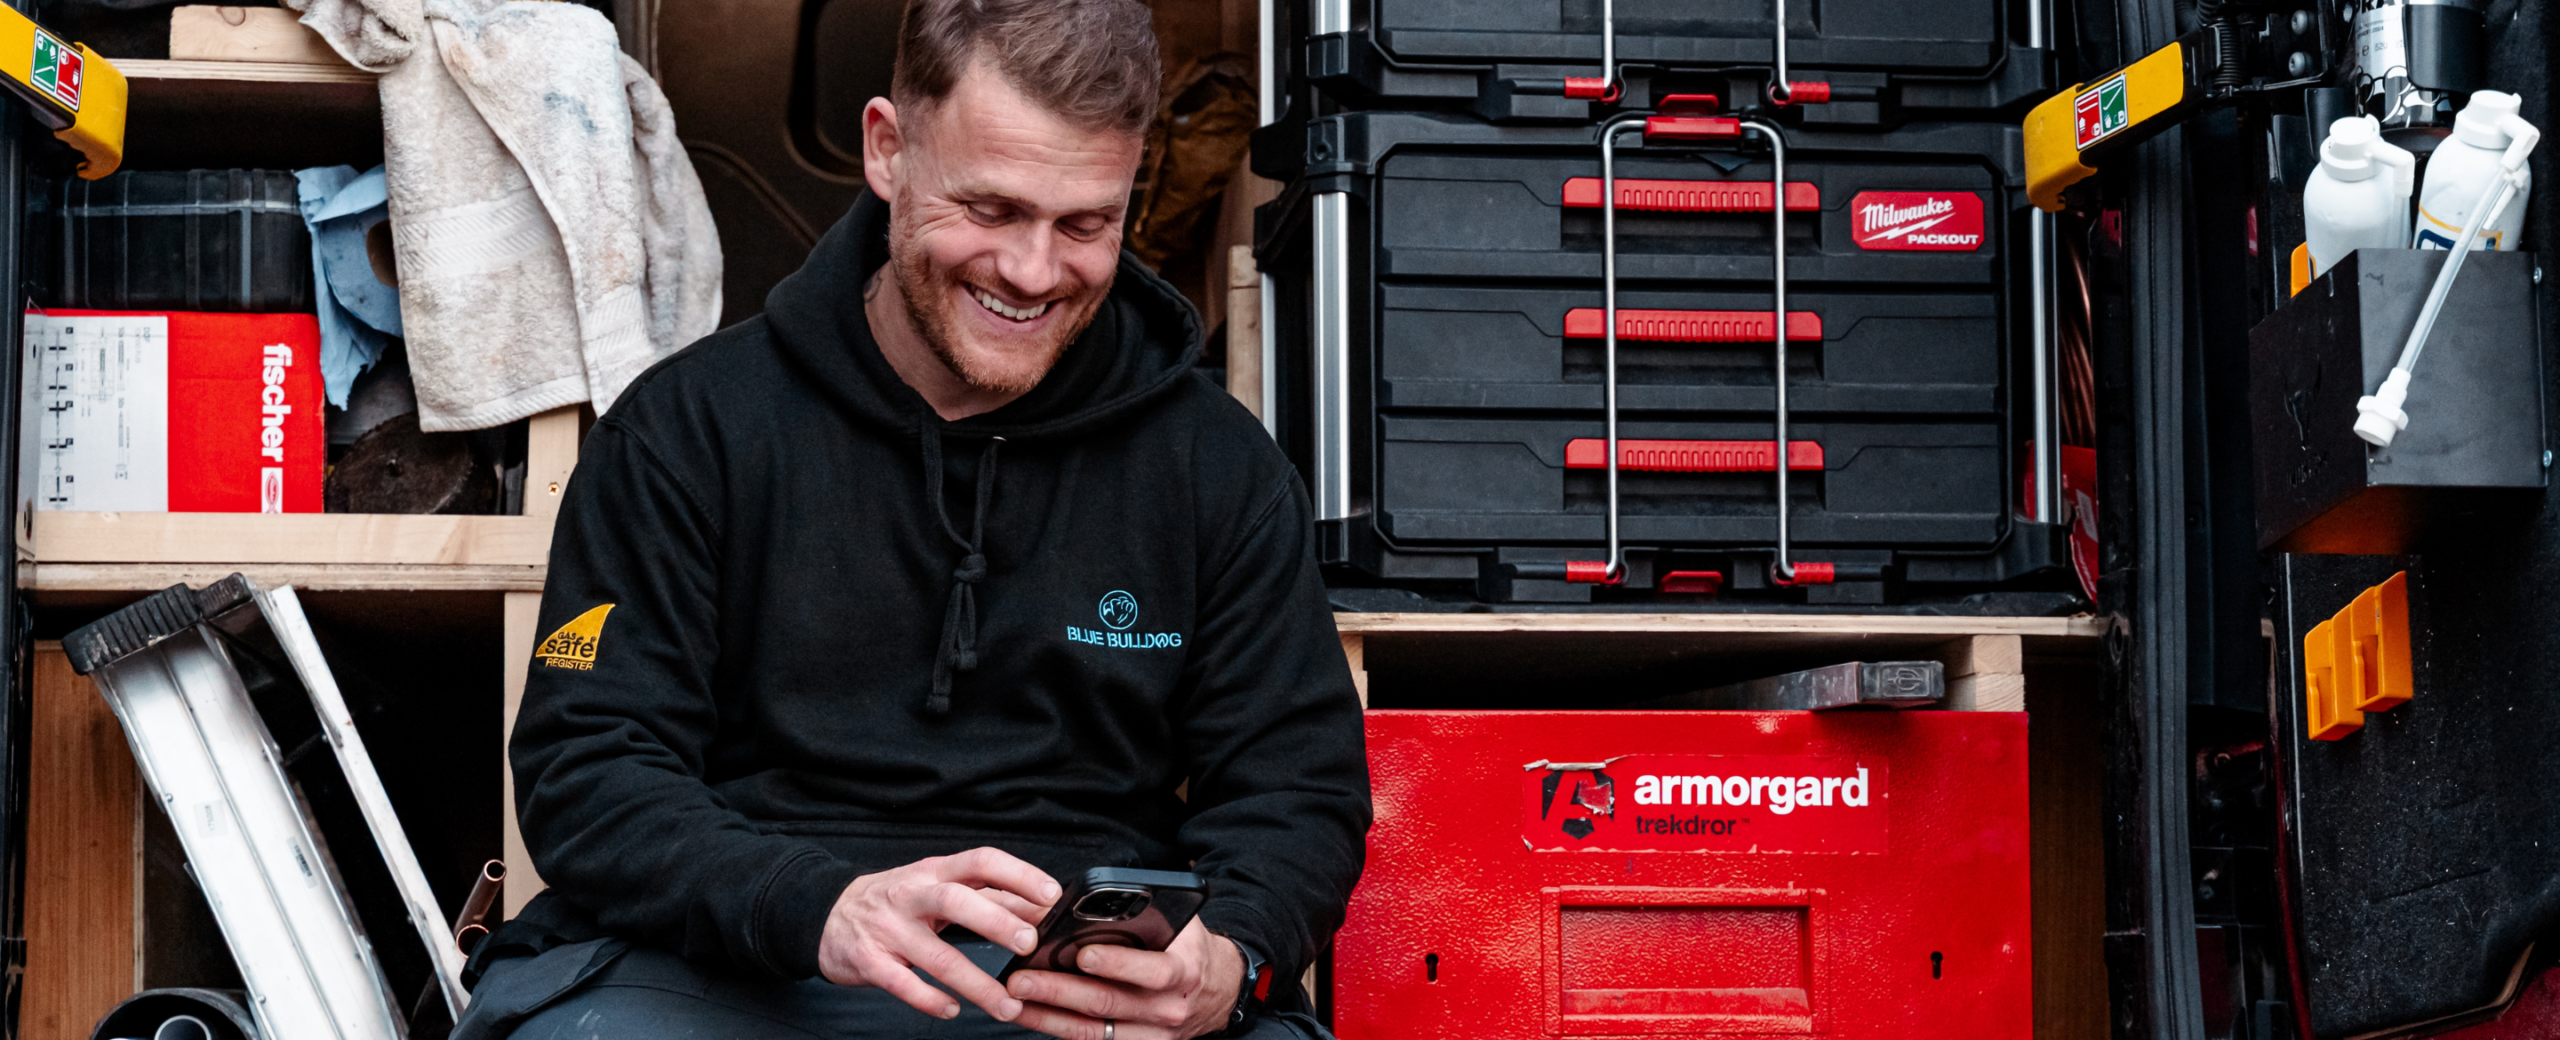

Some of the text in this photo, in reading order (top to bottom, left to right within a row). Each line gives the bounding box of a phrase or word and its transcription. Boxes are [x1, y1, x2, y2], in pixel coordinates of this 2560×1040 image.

[1858, 197, 1954, 232] Milwaukee
[1907, 234, 1979, 245] PACKOUT
[261, 343, 293, 462] fischer
[558, 631, 577, 640] GAS
[1067, 625, 1182, 648] BLUE BULLDOG
[545, 636, 594, 658] safe
[545, 657, 594, 671] REGISTER
[1634, 768, 1868, 815] armorgard
[1635, 815, 1737, 835] trekdror
